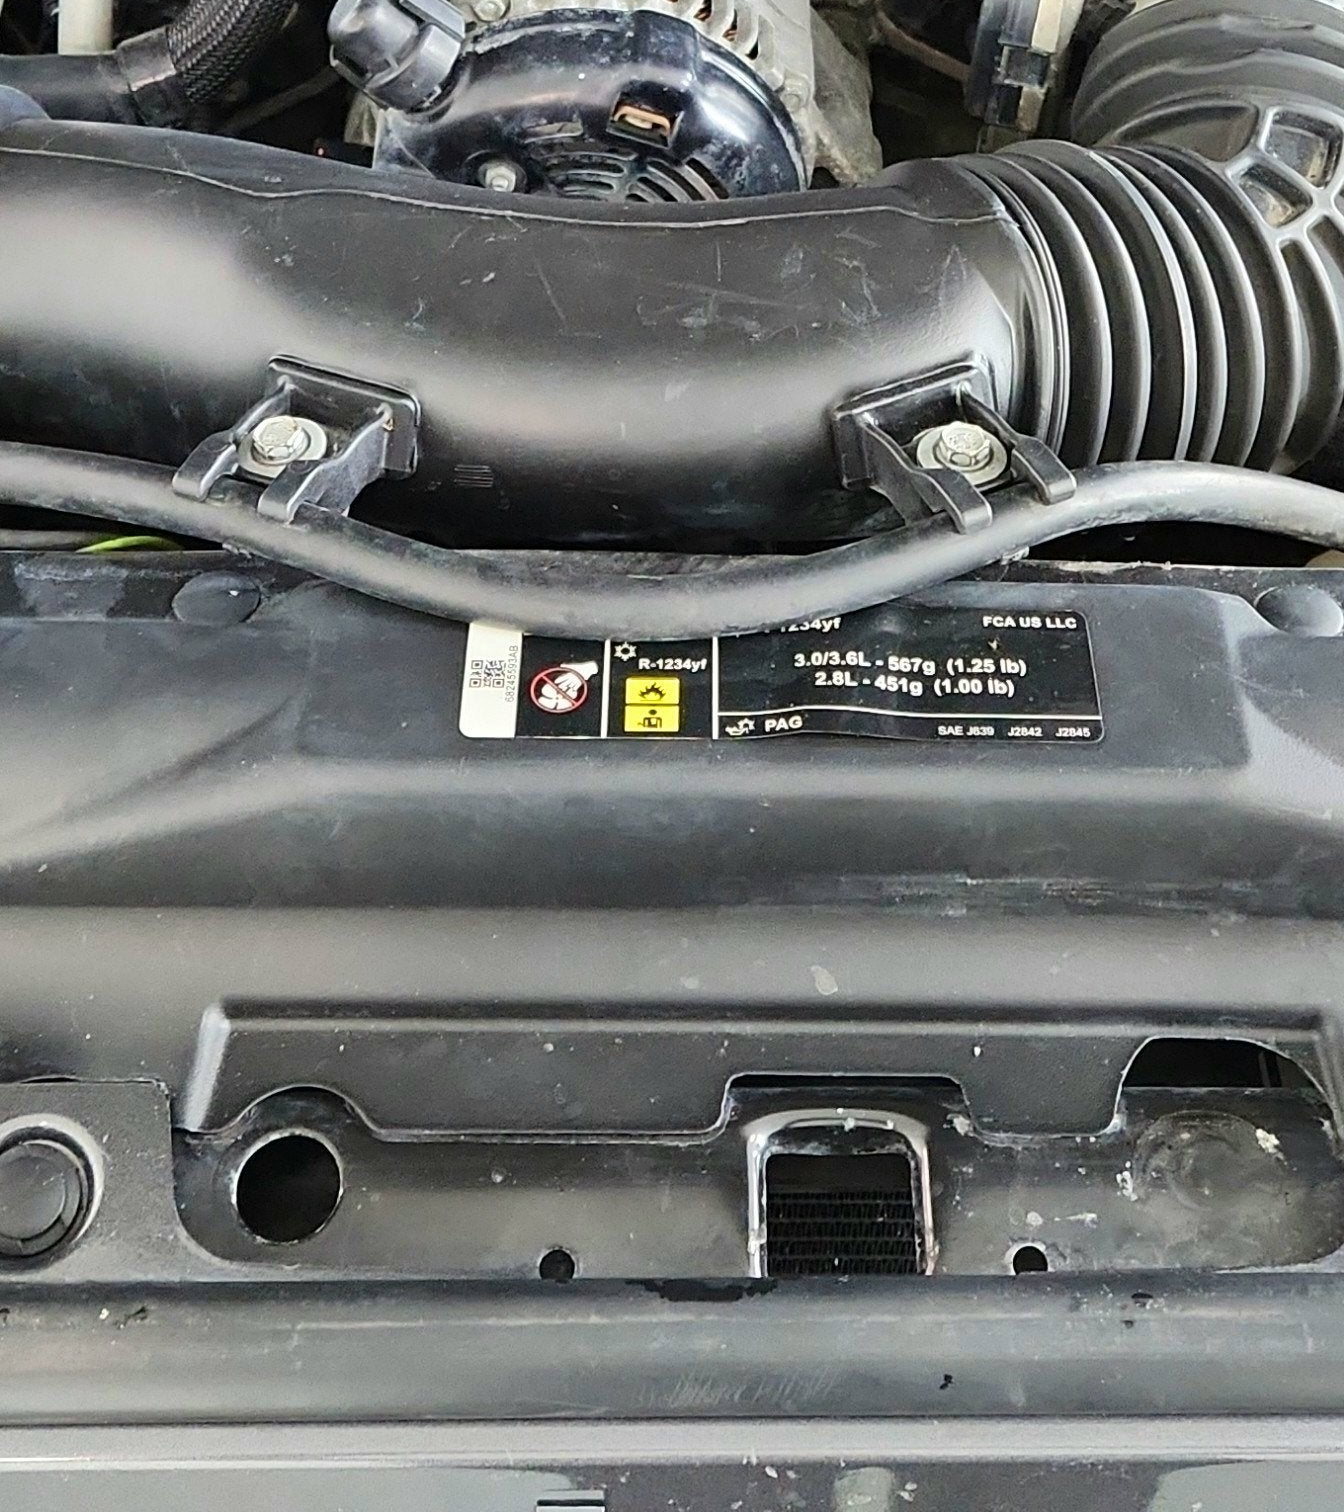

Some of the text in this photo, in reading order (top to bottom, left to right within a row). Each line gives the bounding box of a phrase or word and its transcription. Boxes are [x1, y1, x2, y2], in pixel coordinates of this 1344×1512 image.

[982, 615, 1077, 629] FCA US LLC
[638, 657, 707, 673] R-1234yf
[794, 651, 872, 667] 3.0/3.6L
[887, 655, 936, 676] 567g
[946, 658, 996, 676] (1.25
[999, 658, 1027, 677] lb)
[505, 645, 519, 703] 68245593AB
[814, 671, 858, 687] 2.8L
[874, 674, 923, 697] 451g
[933, 677, 983, 697] (1.00
[987, 678, 1015, 698] lb)
[764, 715, 803, 732] PAG
[937, 725, 964, 736] SAE
[1007, 726, 1043, 737] J2842
[1055, 727, 1091, 738] J2845
